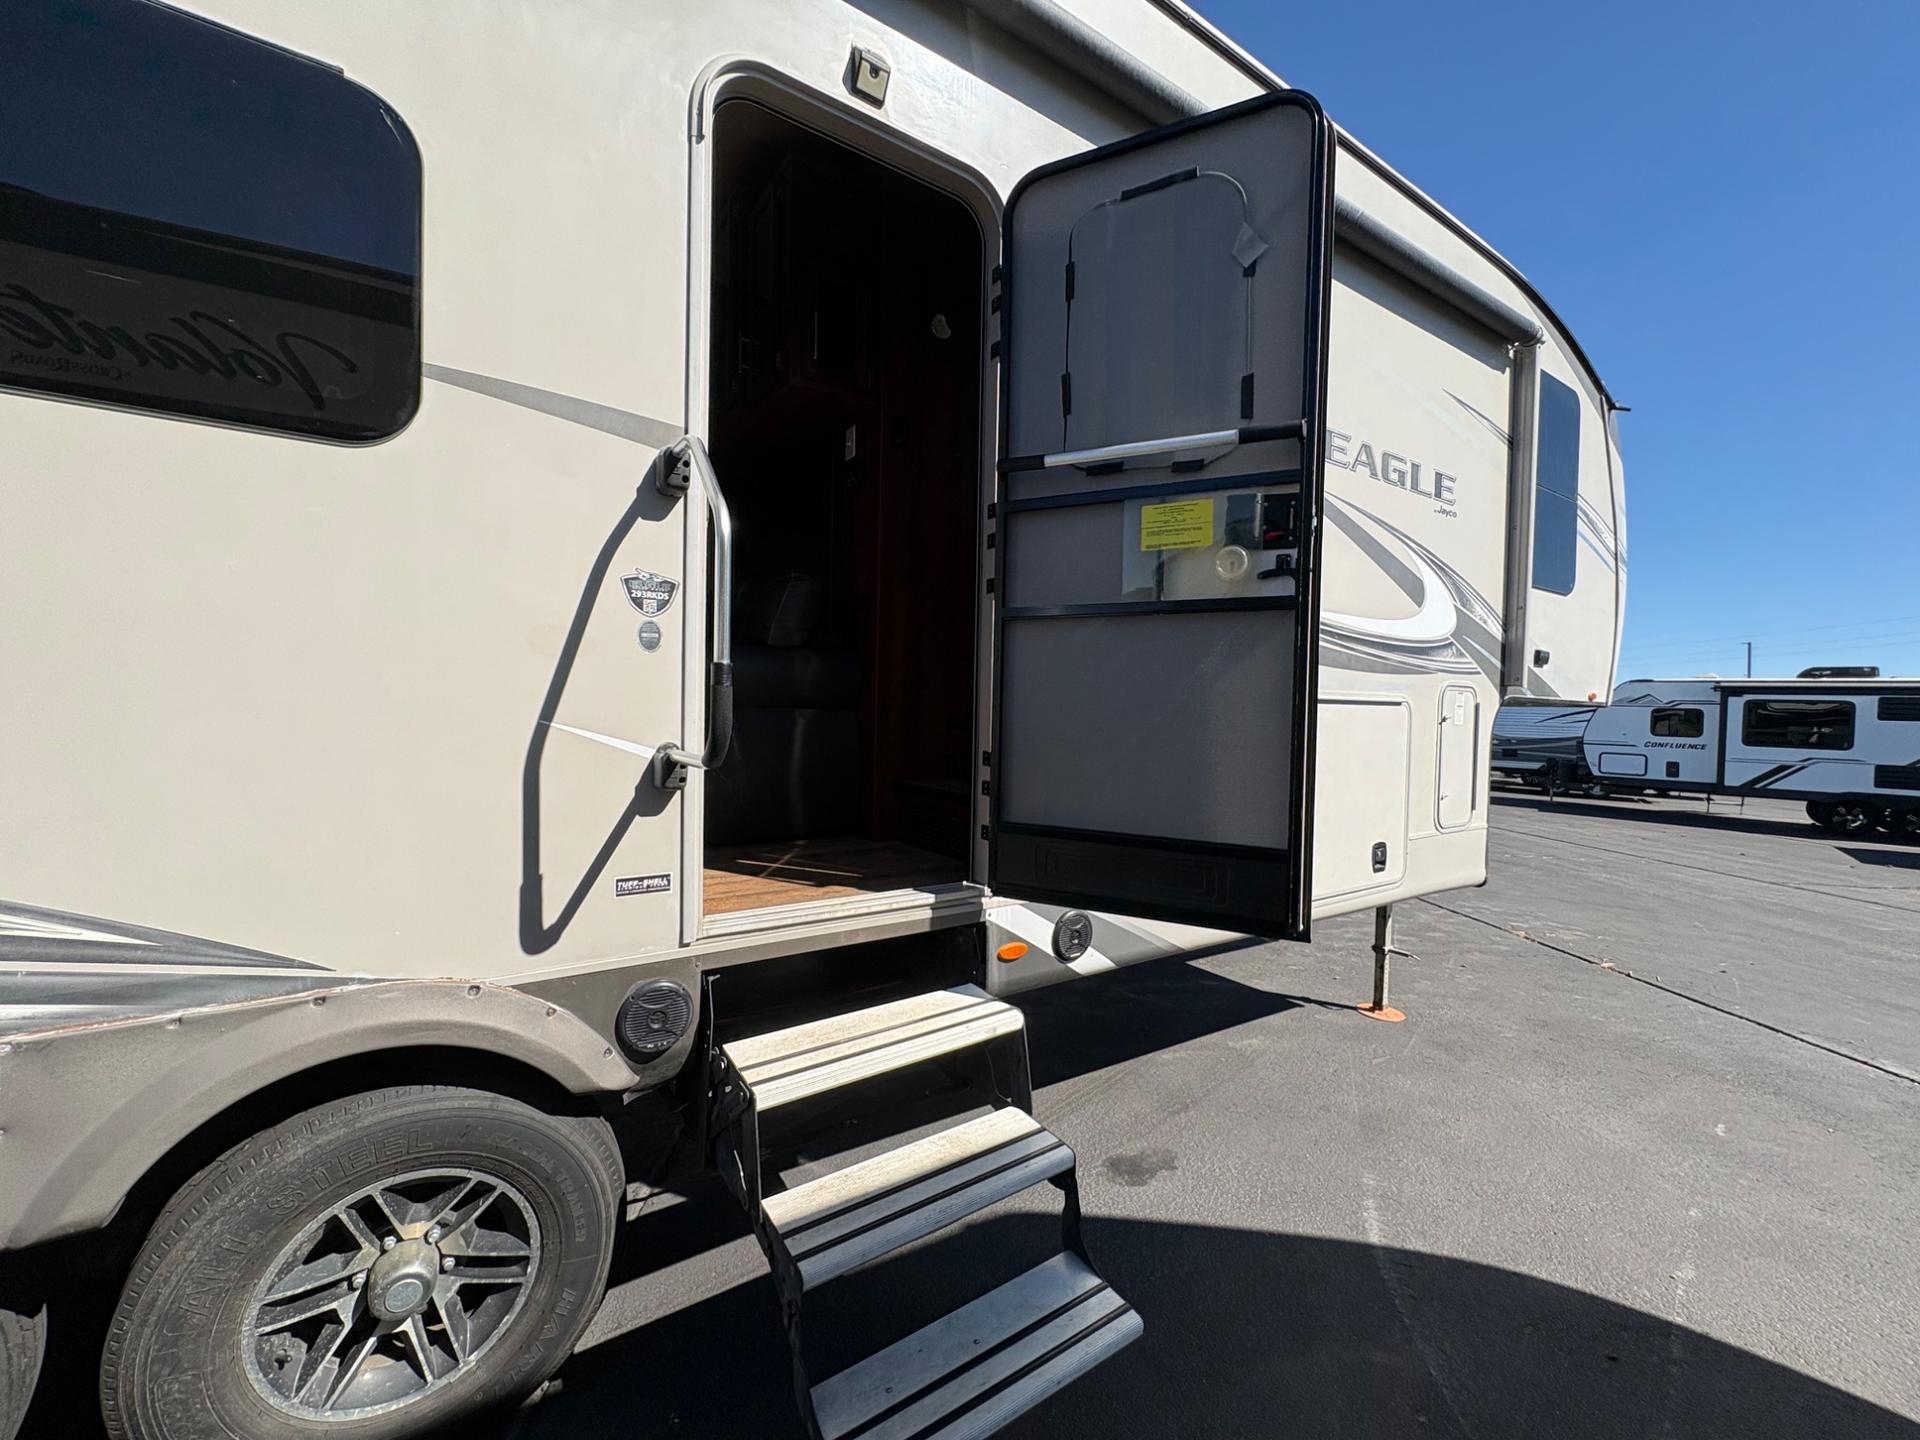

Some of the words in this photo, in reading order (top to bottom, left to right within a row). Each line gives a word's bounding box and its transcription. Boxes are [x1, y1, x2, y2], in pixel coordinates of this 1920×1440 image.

[1325, 427, 1457, 507] EAGLE
[1643, 741, 1708, 750] CONFLUENCE
[266, 1127, 433, 1216] STEEL
